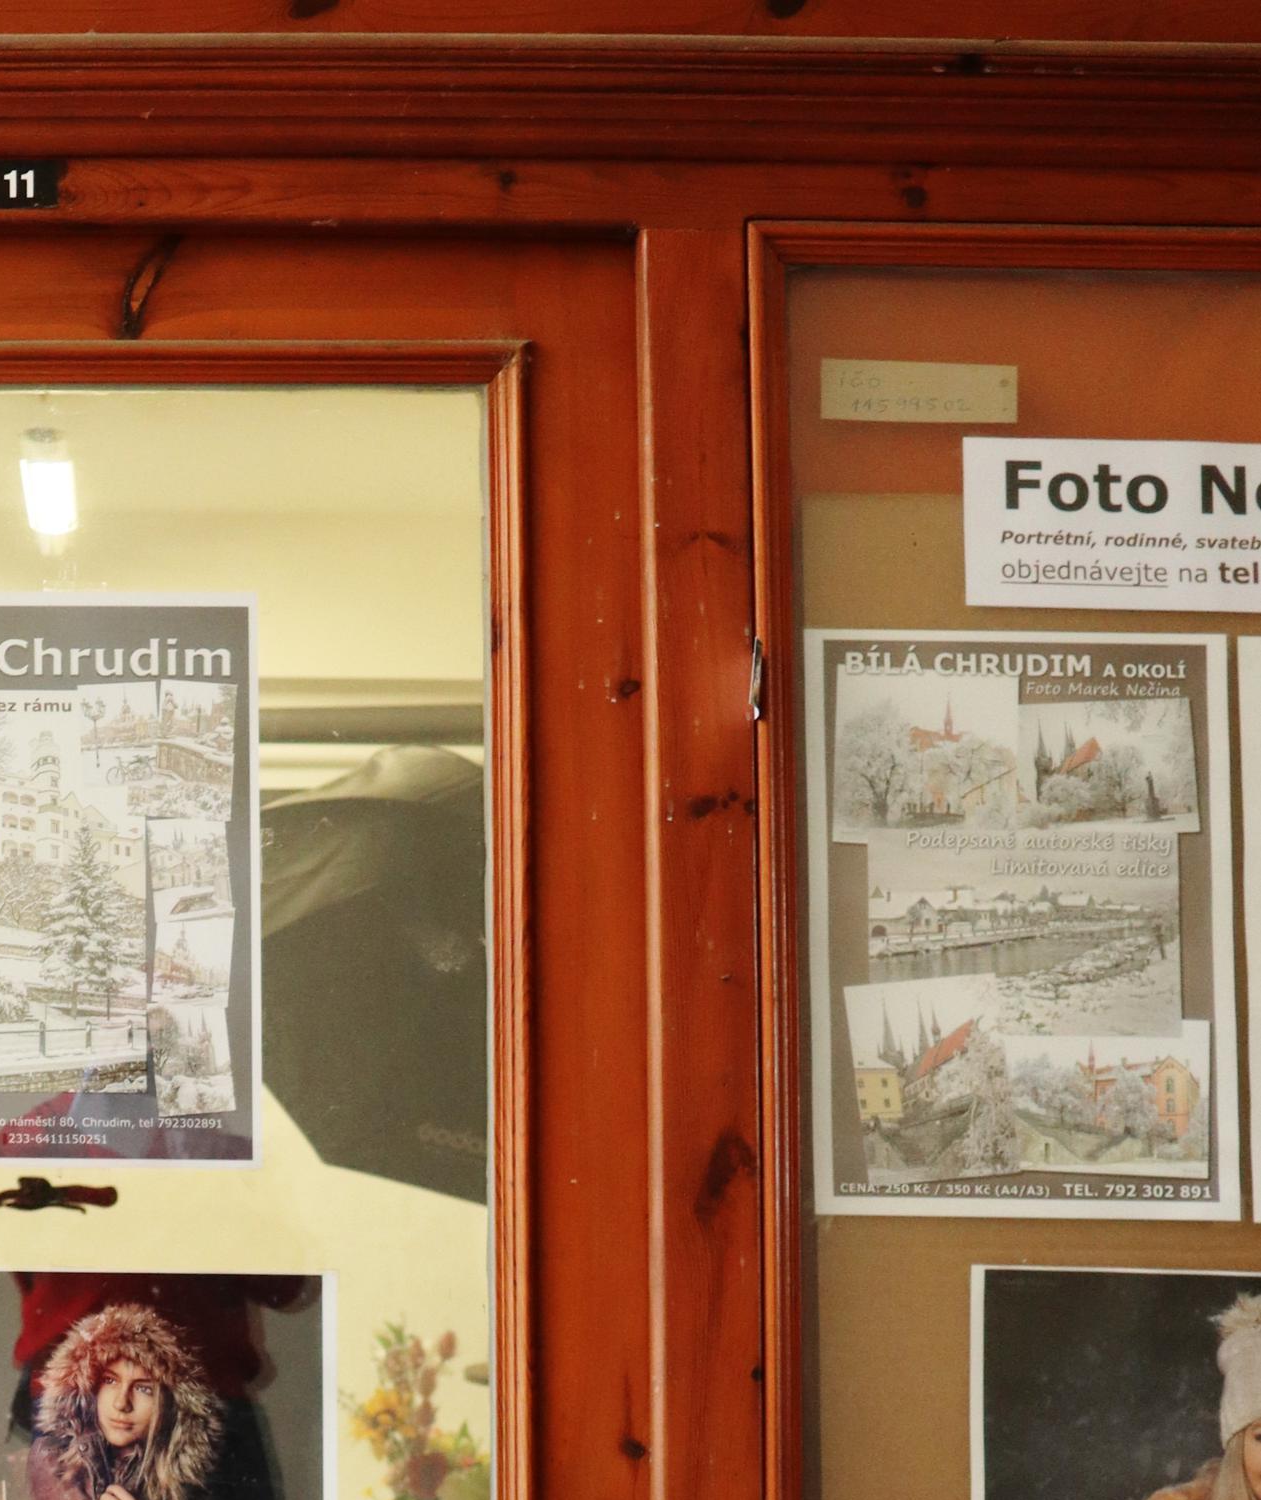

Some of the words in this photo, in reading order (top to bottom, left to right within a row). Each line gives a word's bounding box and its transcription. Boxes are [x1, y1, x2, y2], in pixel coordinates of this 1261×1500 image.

[3, 169, 35, 198] 11
[1005, 460, 1168, 514] Foto
[1201, 465, 1261, 515] N
[1001, 530, 1096, 548] Portrétní,
[1104, 532, 1187, 551] rodinné,
[1001, 559, 1168, 584] objednávejte
[1178, 564, 1207, 583] na
[844, 645, 925, 676] BÍLÁ
[933, 652, 1092, 678] CHRUDIM
[1102, 662, 1117, 678] A
[1122, 660, 1186, 679] OKOLÍ
[1025, 681, 1061, 696] Foto
[1067, 681, 1119, 697] Marek
[1125, 681, 1181, 698] Nečina
[24, 697, 72, 713] rámu
[906, 830, 1017, 853] Podepsané
[1023, 831, 1113, 851] autorské
[1121, 832, 1173, 855] tisky
[990, 858, 1108, 877] Limitovaná
[1116, 860, 1169, 878] edice
[9, 1116, 56, 1127] náměstí
[59, 1117, 78, 1129] 80,
[82, 1116, 136, 1129] Chrudim,
[139, 1117, 153, 1128] tel
[157, 1118, 222, 1129] 792302891
[840, 1183, 880, 1194] CENA:
[884, 1183, 909, 1195] 250
[913, 1183, 930, 1195] Kč
[946, 1184, 970, 1196] 350
[974, 1184, 990, 1196] Kč
[995, 1184, 1050, 1198] (A4/A3)
[1062, 1183, 1098, 1197] TEL.
[1104, 1184, 1136, 1198] 792
[1142, 1184, 1175, 1198] 302
[1180, 1185, 1212, 1199] 891
